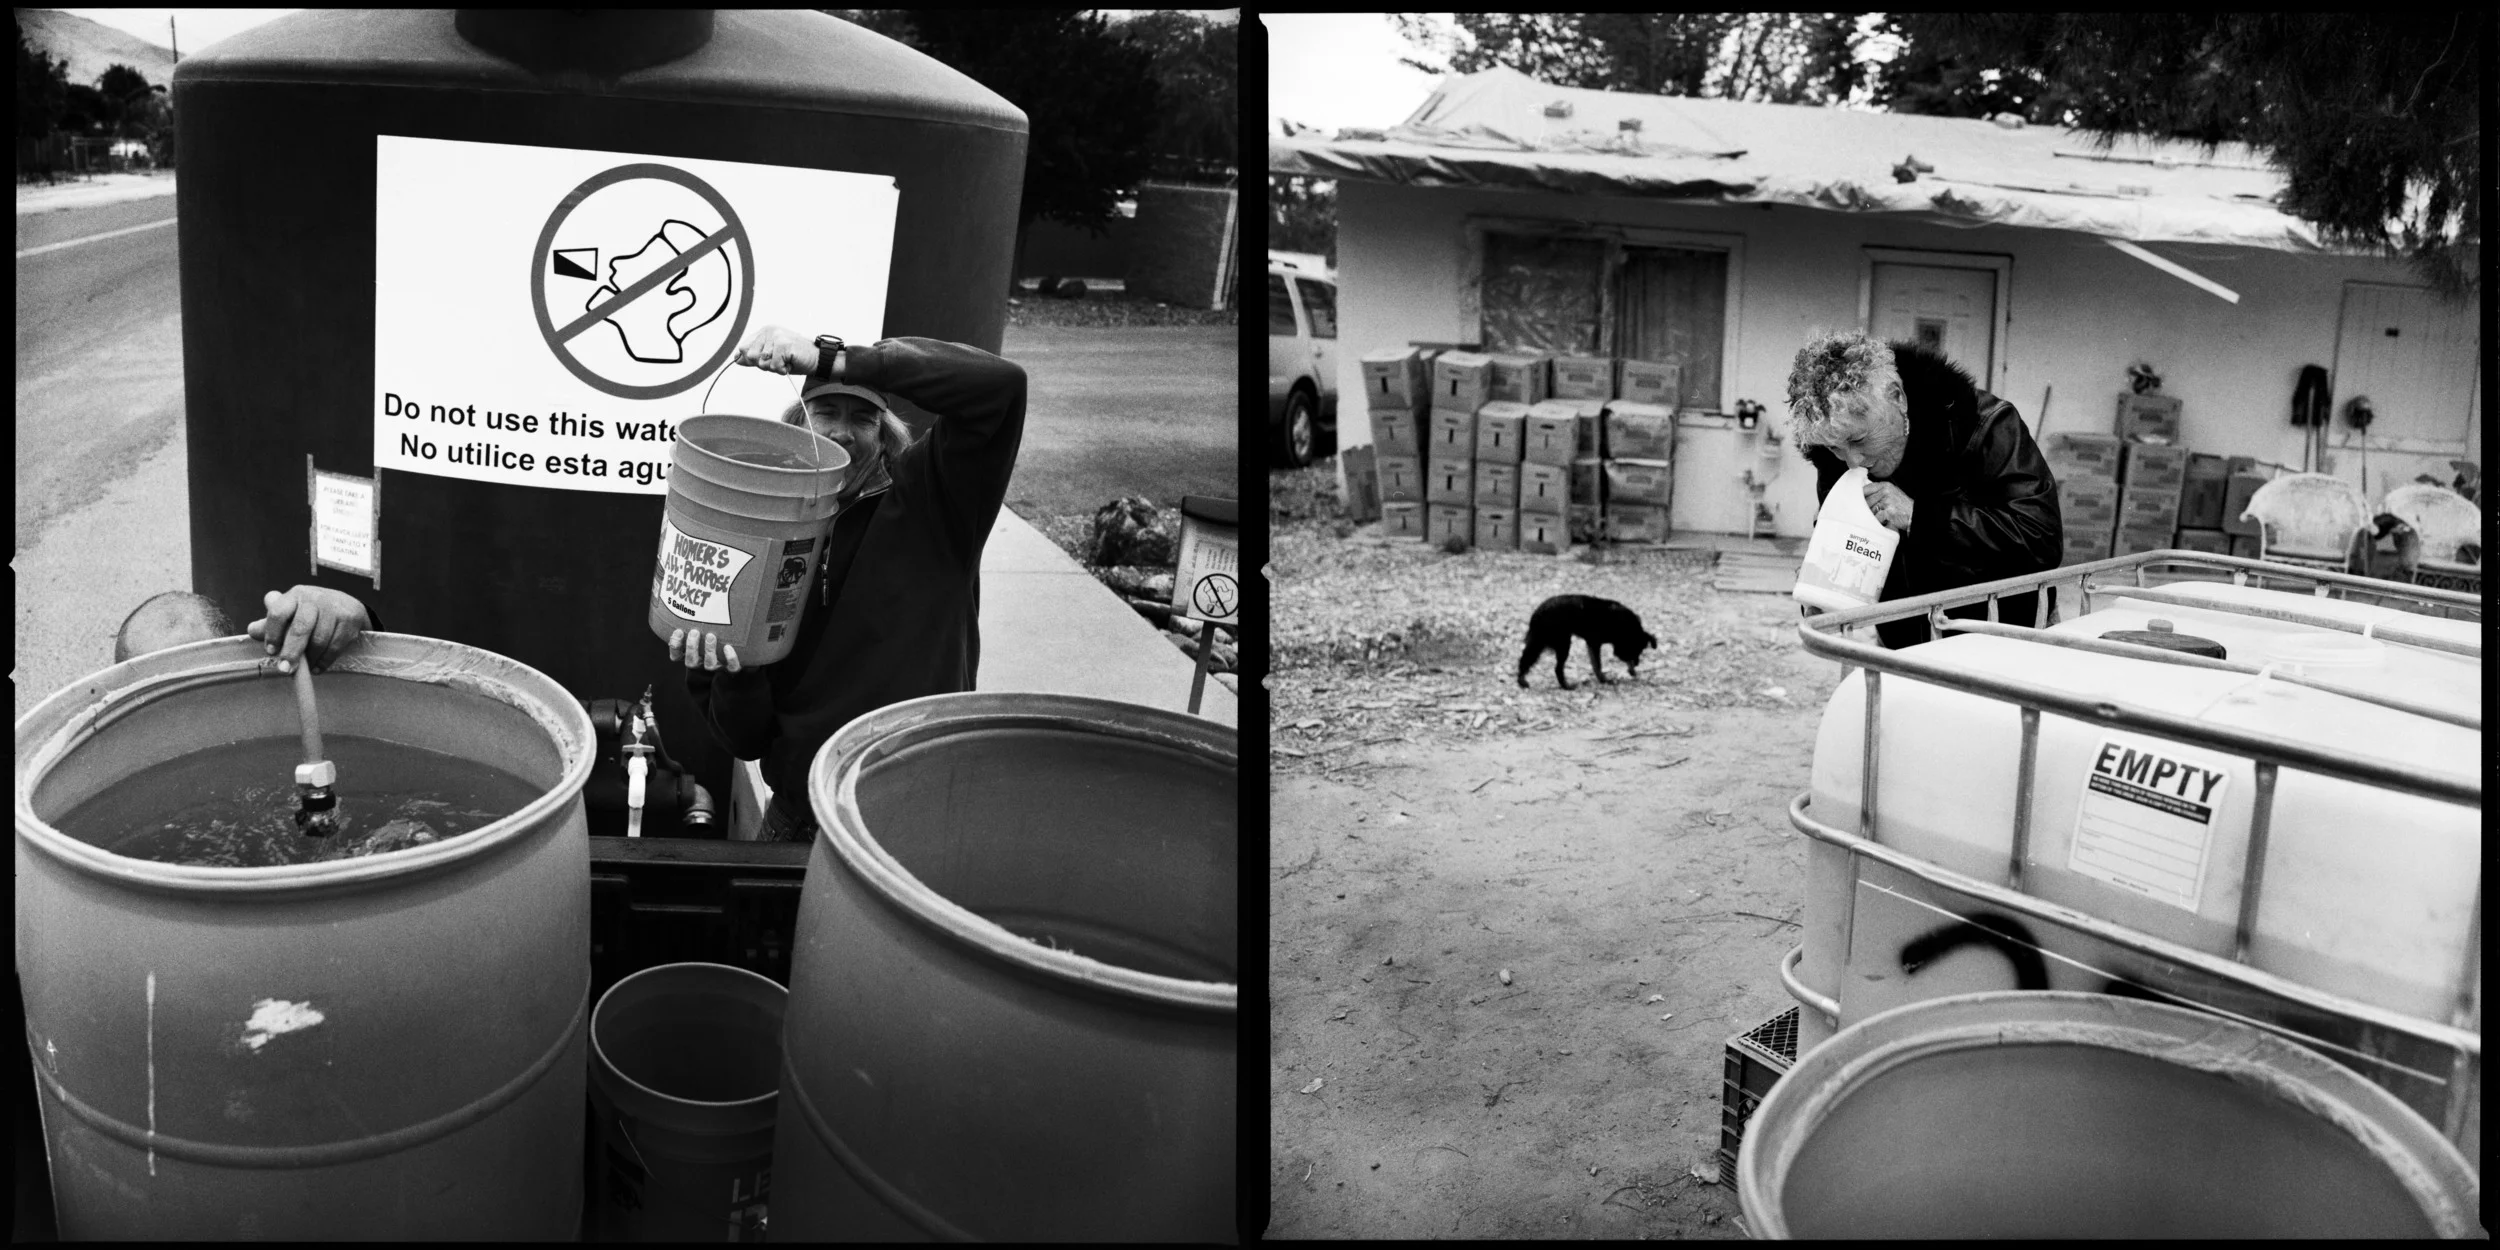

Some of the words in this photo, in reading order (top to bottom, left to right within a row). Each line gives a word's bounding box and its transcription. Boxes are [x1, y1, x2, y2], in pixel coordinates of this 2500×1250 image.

[385, 392, 420, 420] Do
[431, 404, 476, 428] not
[486, 411, 539, 433] use
[549, 411, 605, 439] this
[615, 419, 677, 443] wat
[401, 432, 438, 460] No
[447, 442, 535, 472] utilice
[545, 454, 608, 477] esta
[618, 460, 673, 486] agu
[673, 533, 730, 569] HOMER'S
[1846, 539, 1882, 561] Bleach
[1850, 534, 1870, 544] simply
[666, 574, 712, 608] BUCKET
[667, 596, 672, 605] 5
[672, 599, 696, 617] Gallons
[2094, 741, 2224, 803] EMPTY
